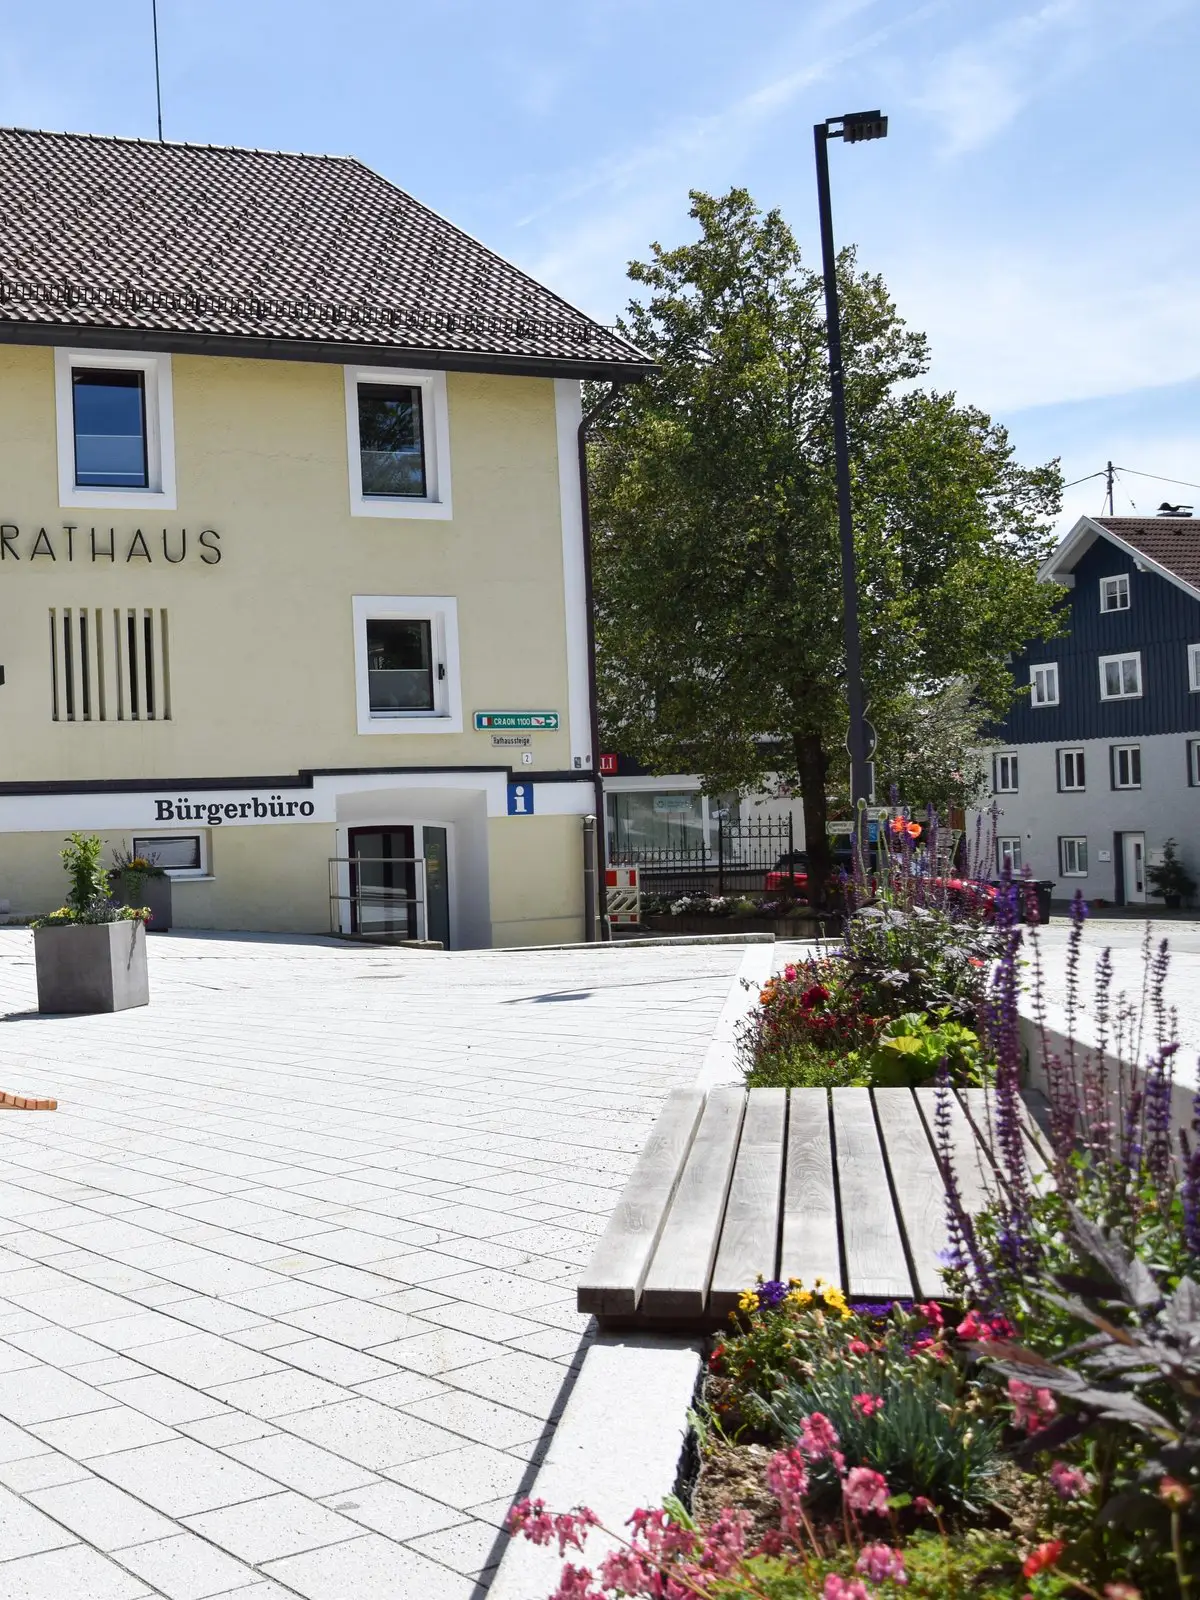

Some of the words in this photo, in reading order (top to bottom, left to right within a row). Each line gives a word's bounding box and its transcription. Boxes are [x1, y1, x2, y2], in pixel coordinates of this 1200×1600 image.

[0, 525, 222, 564] RATHAUS
[493, 717, 516, 726] CRAON
[517, 717, 531, 726] 1100
[493, 736, 530, 746] Rathaussteige
[600, 757, 613, 770] LI
[154, 795, 315, 825] Bürgerbüro
